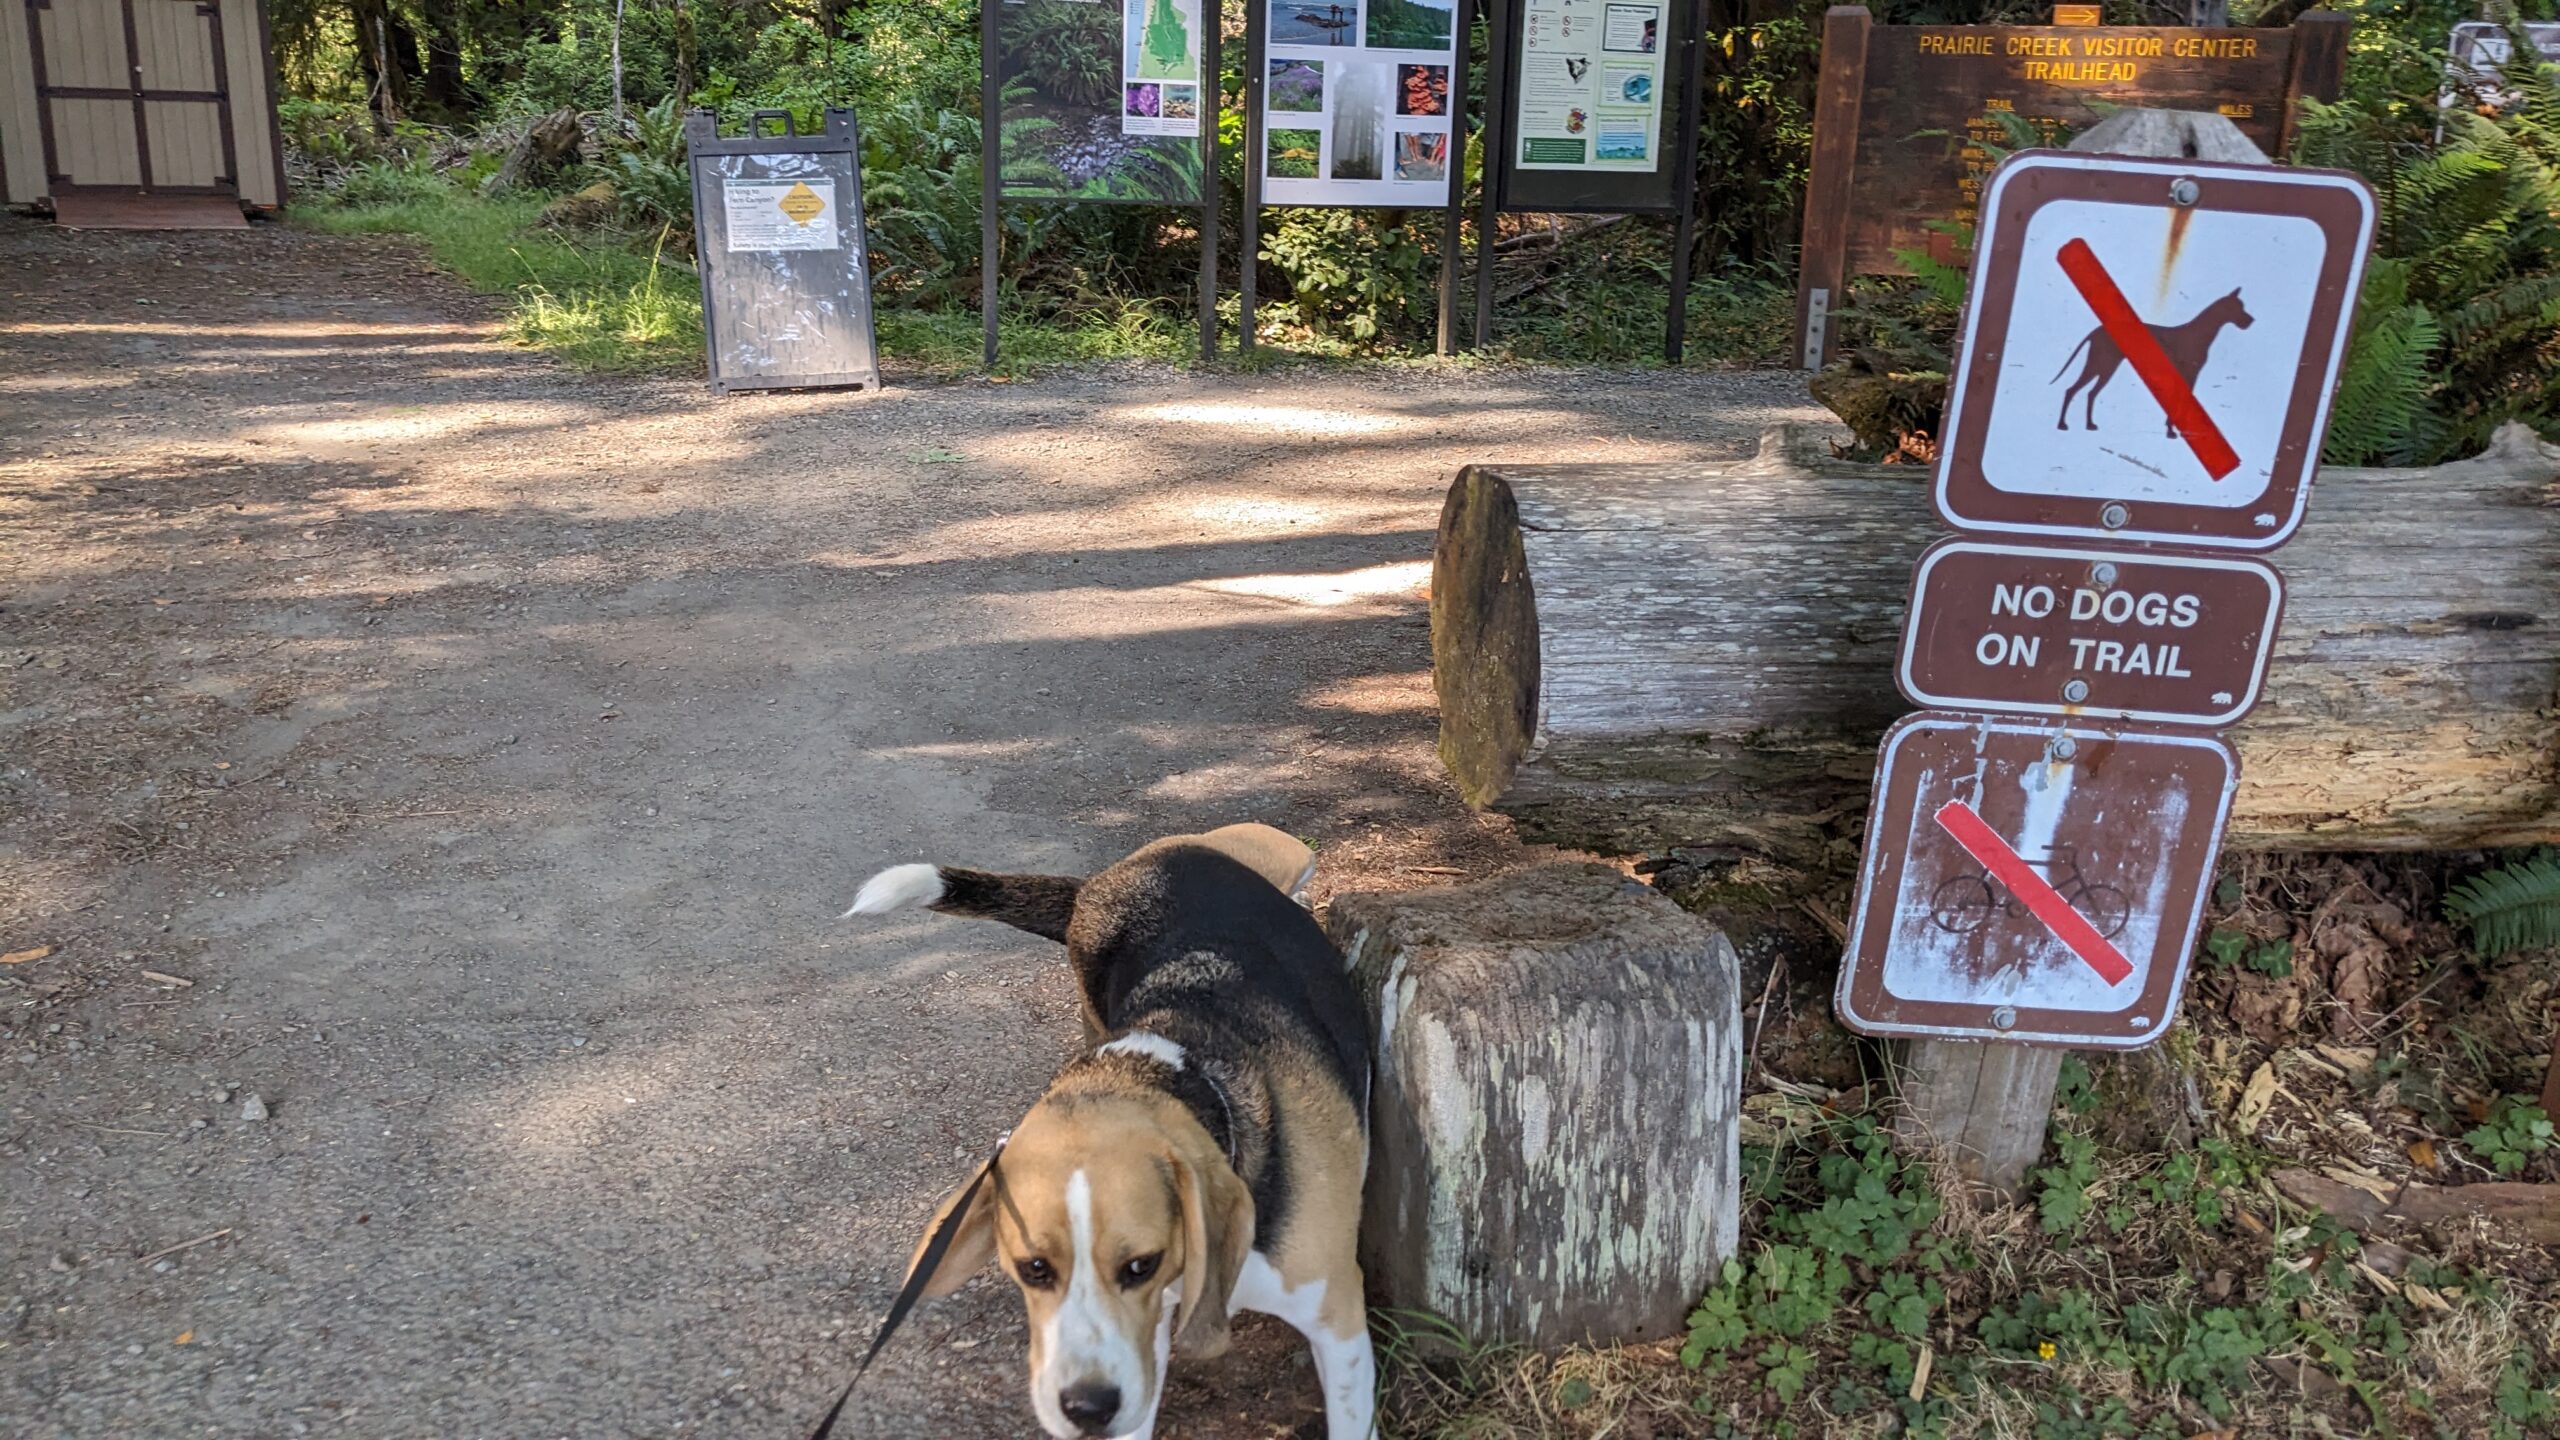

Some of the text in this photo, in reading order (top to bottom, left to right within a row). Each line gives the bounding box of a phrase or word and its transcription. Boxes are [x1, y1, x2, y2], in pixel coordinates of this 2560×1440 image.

[1919, 36, 2258, 58] PRAIRIE CREEK VISITOR CENTER
[2025, 61, 2137, 82] TRAILHEAD
[1991, 583, 2202, 628] NO DOGS
[1976, 632, 2193, 678] ON TRAIL
